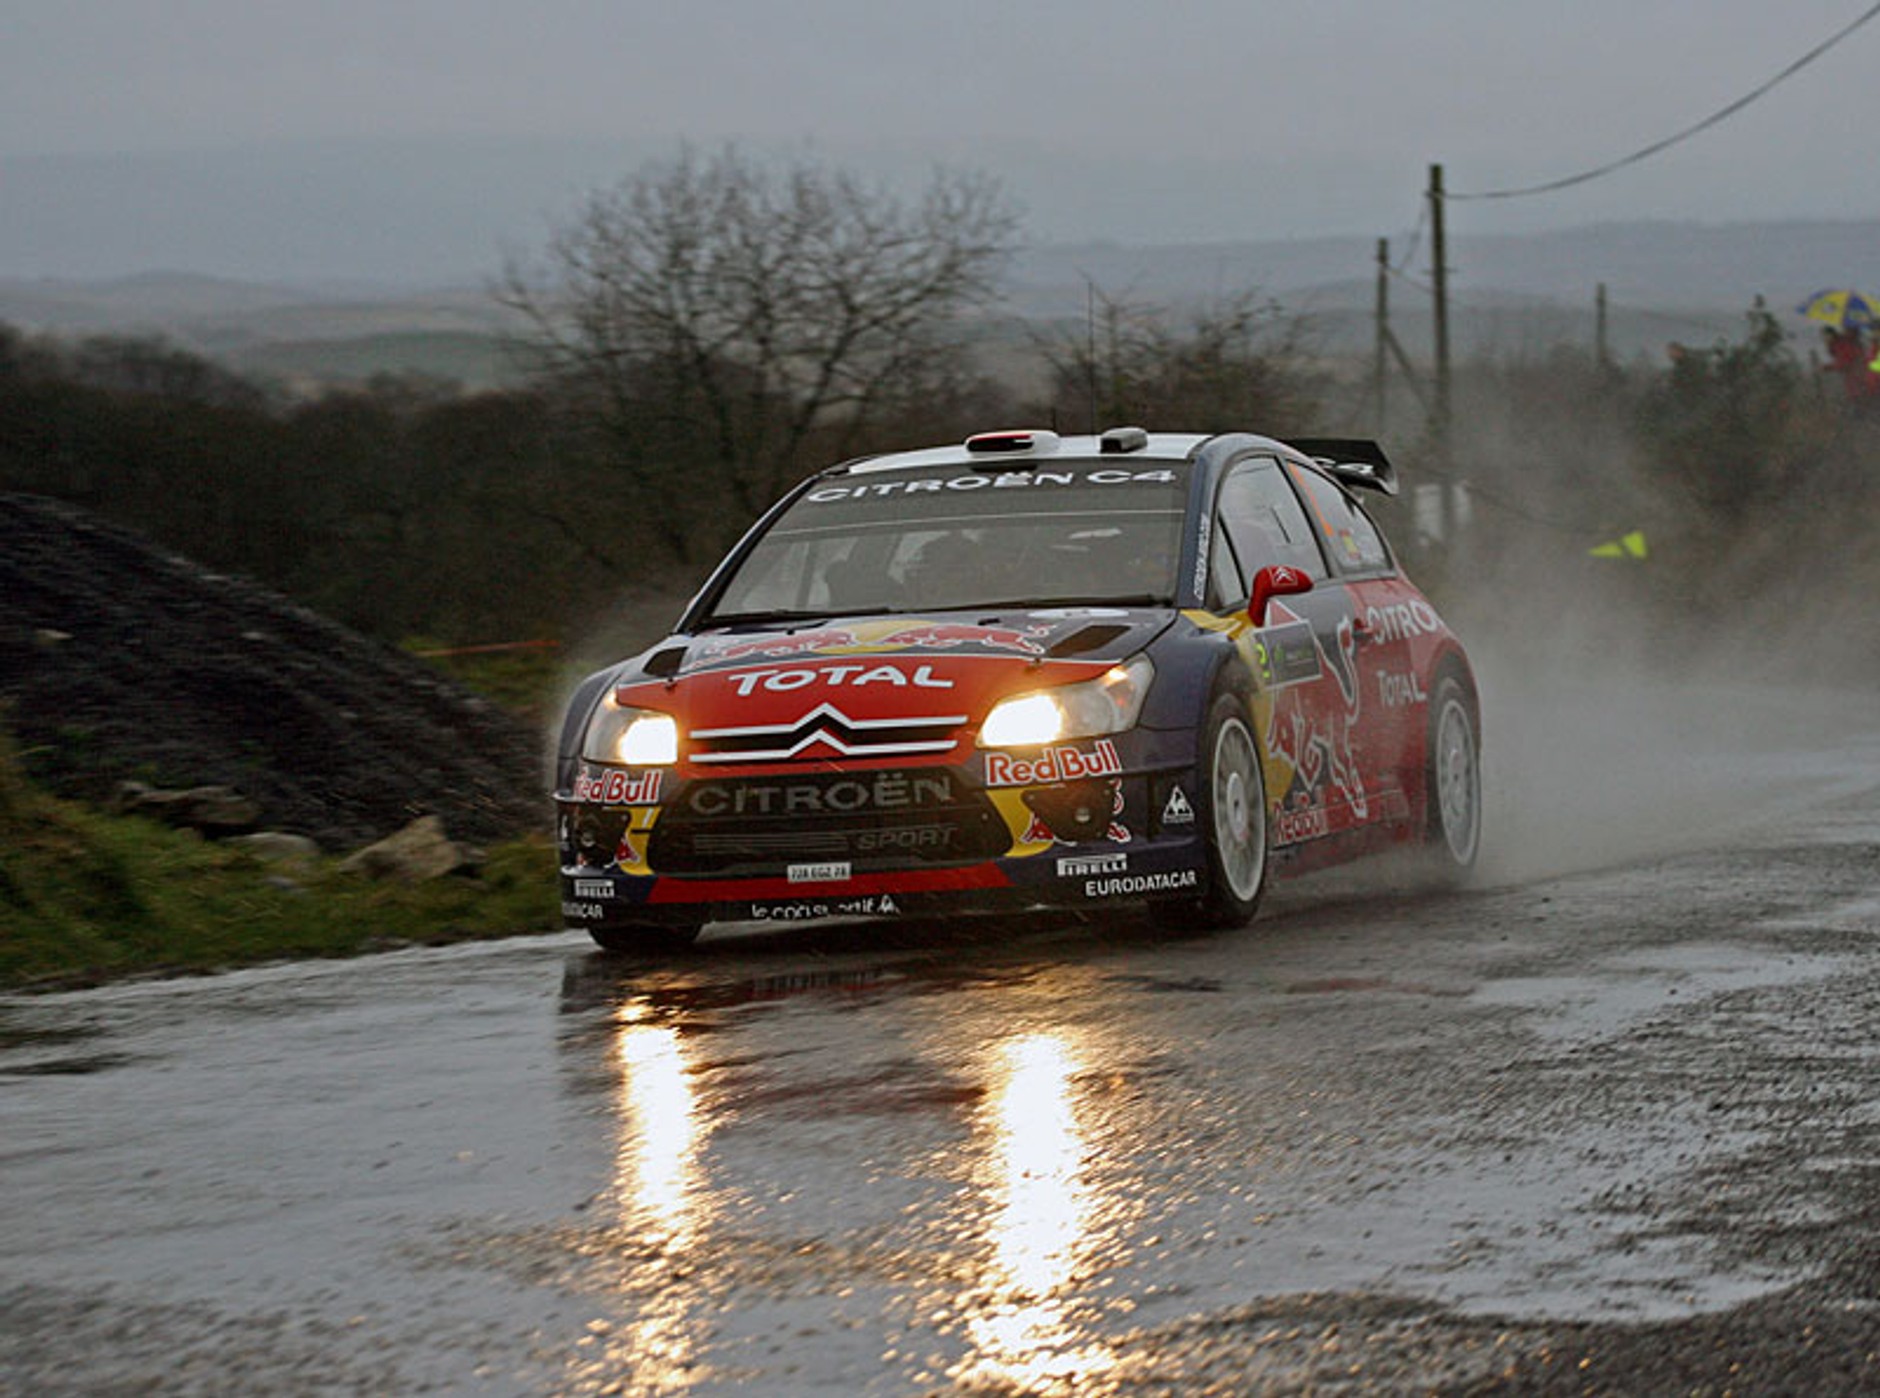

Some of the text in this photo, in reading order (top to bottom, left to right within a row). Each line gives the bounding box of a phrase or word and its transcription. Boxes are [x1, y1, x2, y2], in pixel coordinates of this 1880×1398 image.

[807, 469, 1176, 502] CITROËN C4
[728, 665, 954, 697] TOTAL
[1377, 670, 1426, 707] TOTAL
[985, 740, 1122, 786] Red Bull
[604, 769, 663, 805] Bull
[690, 772, 950, 813] CITROËN
[856, 823, 958, 851] SPORT
[1057, 852, 1127, 877] PIRELLI
[1085, 870, 1198, 897] EURODATACAR
